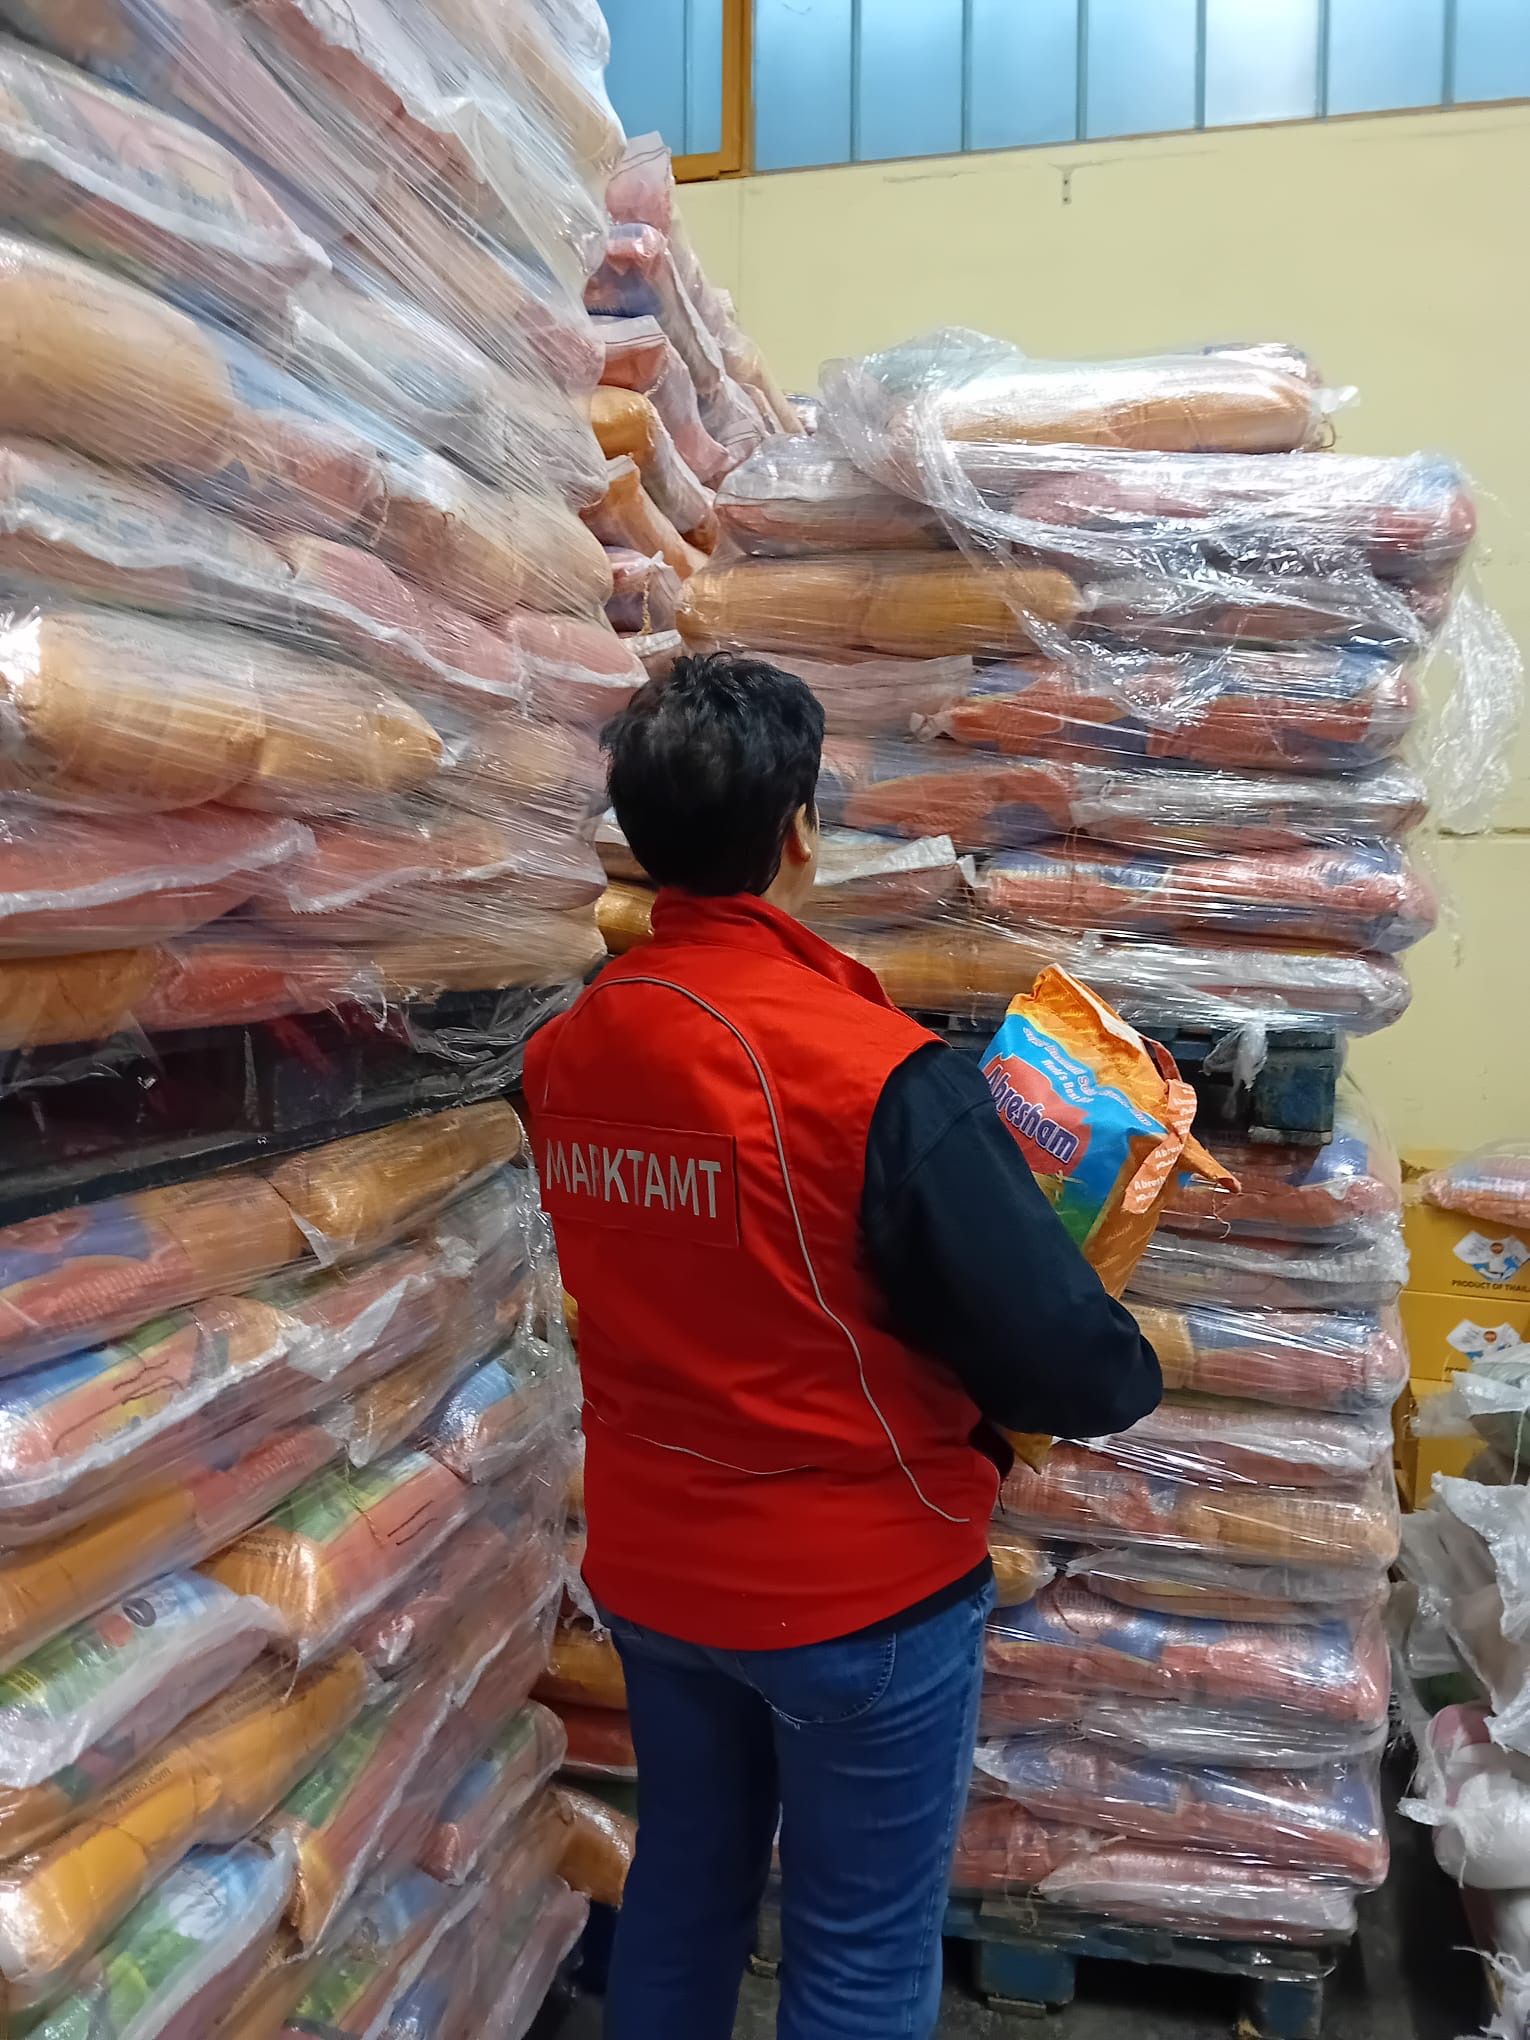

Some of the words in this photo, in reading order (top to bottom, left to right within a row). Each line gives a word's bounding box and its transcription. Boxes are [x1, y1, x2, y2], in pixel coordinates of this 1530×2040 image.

[986, 1065, 1080, 1165] Abresham
[545, 1138, 722, 1219] MARKTAMT
[1451, 1279, 1491, 1290] PRODUCT
[1492, 1282, 1503, 1291] OF
